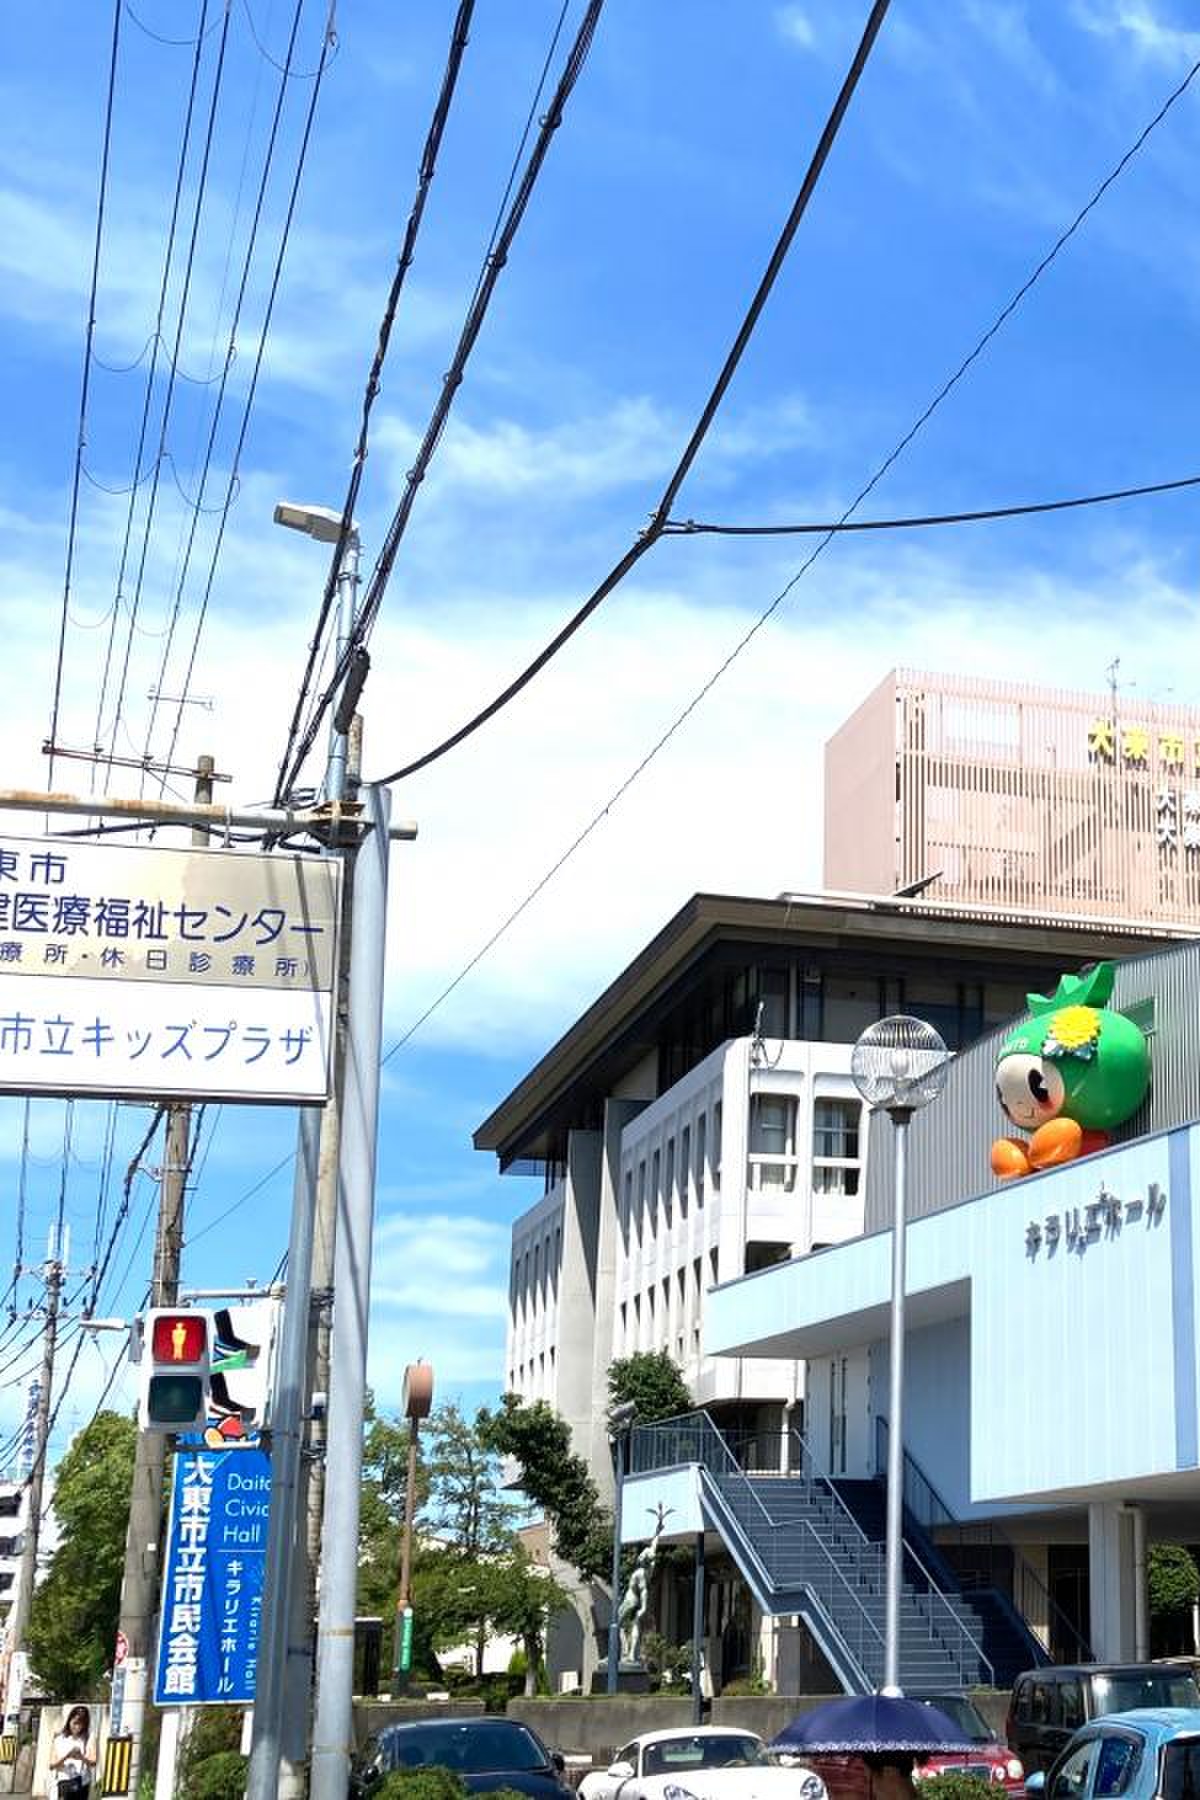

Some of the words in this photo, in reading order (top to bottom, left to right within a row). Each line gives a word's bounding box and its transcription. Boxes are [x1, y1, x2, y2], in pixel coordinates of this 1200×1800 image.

[0, 1011, 313, 1066] 市立キッズプラザ
[163, 1455, 216, 1696] 大東市立市民会館
[223, 1525, 260, 1543] Hall
[217, 1559, 243, 1693] キラリエホール
